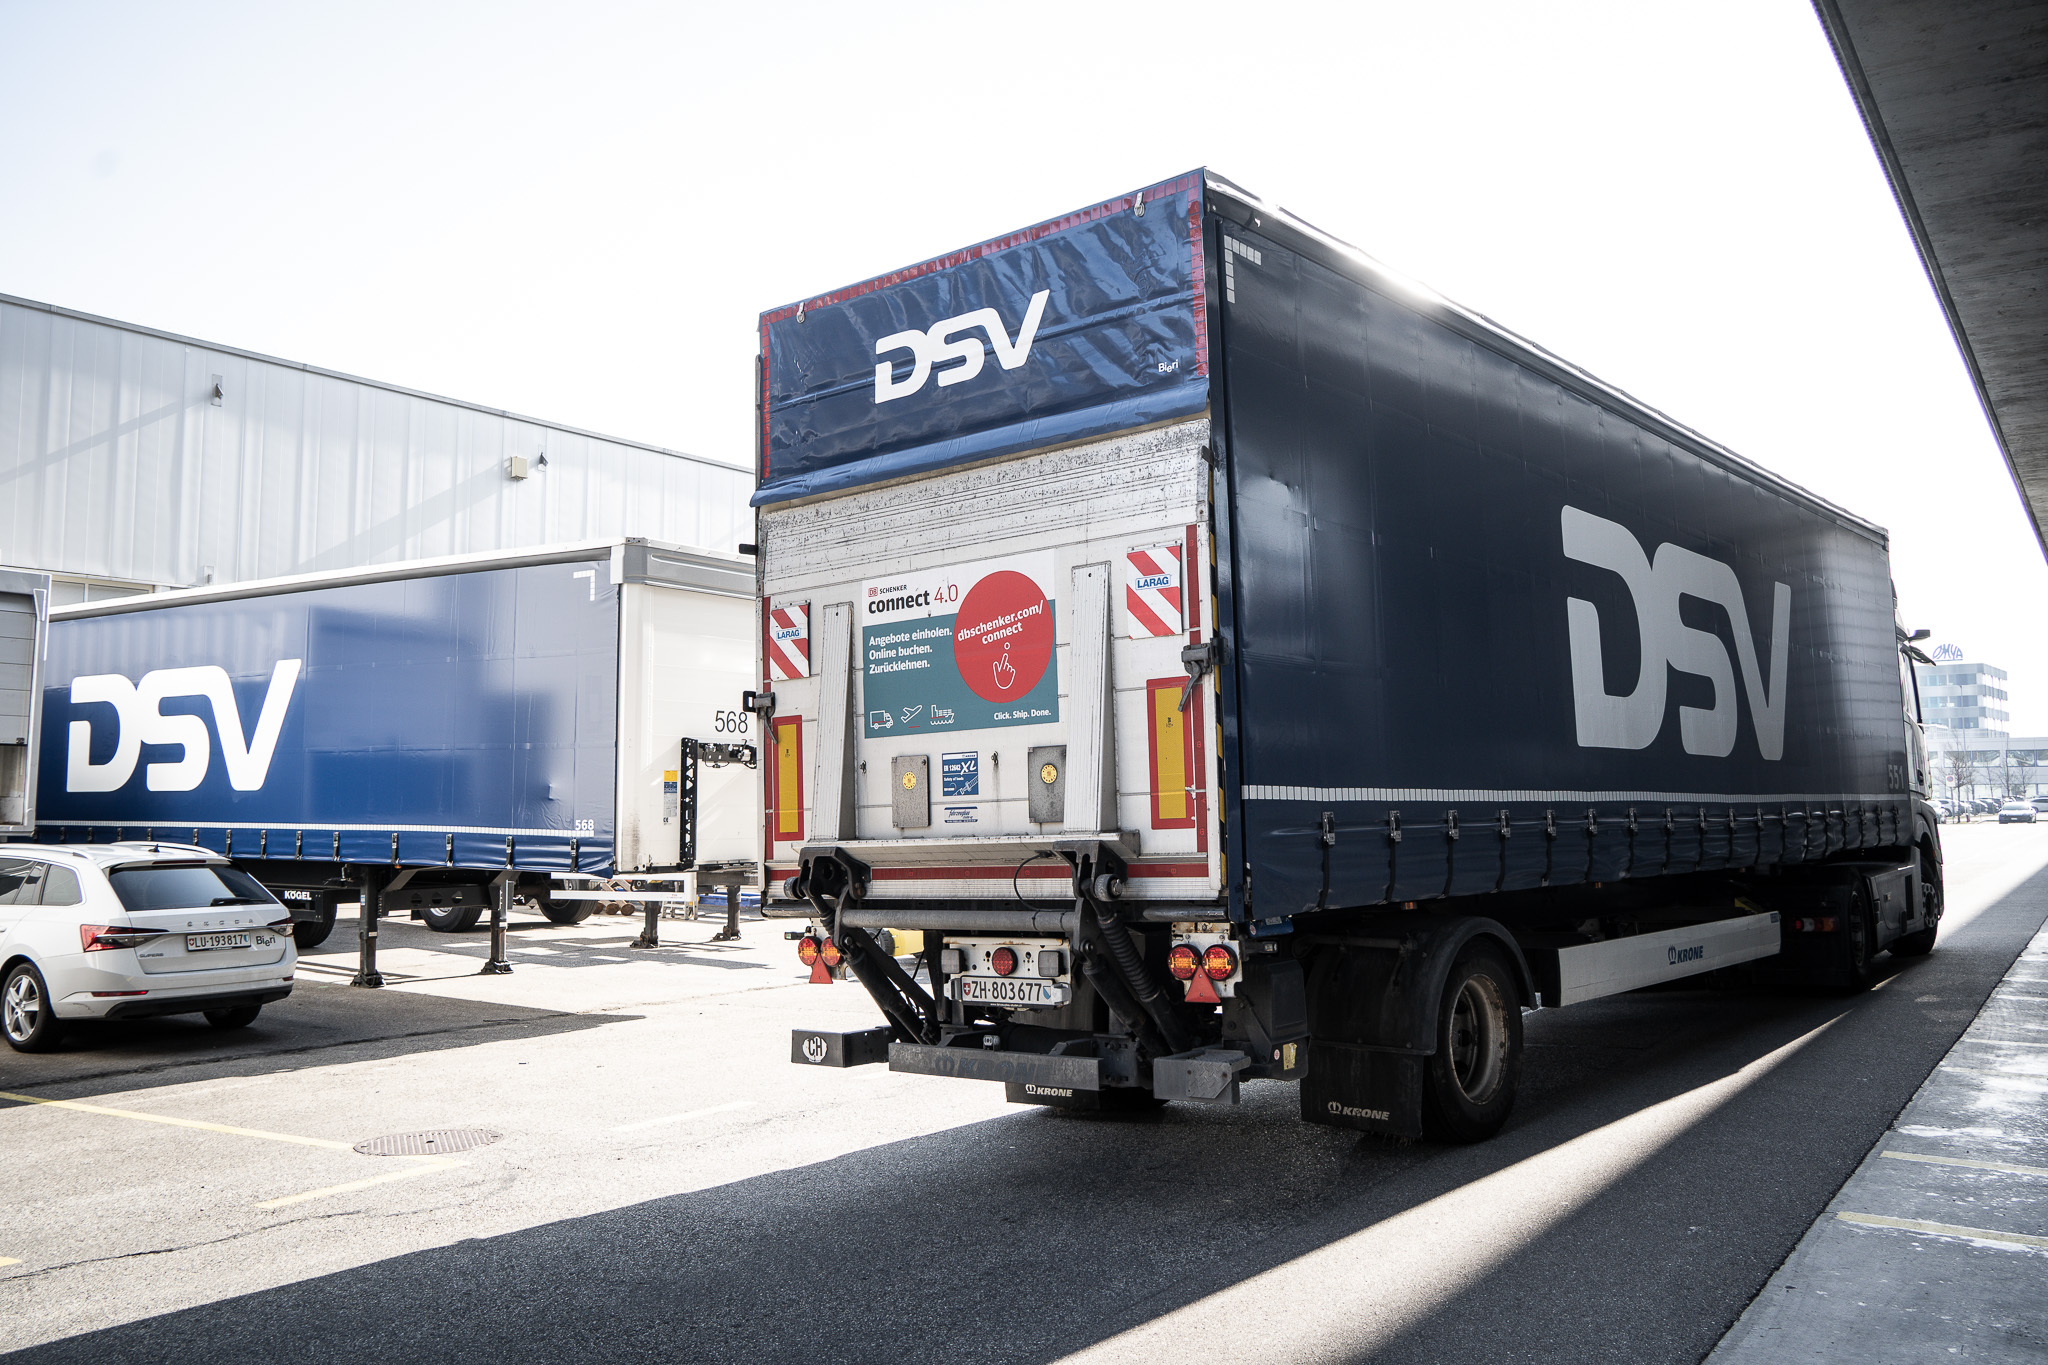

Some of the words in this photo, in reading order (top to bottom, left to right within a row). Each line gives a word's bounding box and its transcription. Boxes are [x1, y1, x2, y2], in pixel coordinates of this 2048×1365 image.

[875, 289, 1050, 404] DSV
[1158, 358, 1178, 372] Bieri
[879, 584, 907, 595] SCHENKER
[1137, 576, 1169, 588] LARAG
[868, 590, 930, 614] connect
[934, 584, 958, 603] 4.0
[957, 600, 1043, 642] dbschenker.com/
[777, 629, 800, 639] LARAG
[869, 631, 910, 647] Angebote
[912, 626, 952, 641] einholen.
[982, 622, 1023, 644] connect
[1561, 504, 1791, 761] DSV
[869, 647, 897, 661] Online
[898, 644, 933, 656] buchen.
[869, 659, 930, 674] Zurücklehnen.
[714, 710, 748, 733] 568
[993, 712, 1012, 721] Click.
[1013, 710, 1030, 720] Ship.
[1031, 709, 1051, 718] Done.
[66, 659, 301, 792] DSV
[961, 760, 977, 776] XL
[1888, 765, 1904, 790] 551
[575, 819, 594, 830] 568
[284, 890, 312, 900] KÖGEL
[256, 935, 276, 946] Bieri
[1677, 945, 1703, 963] KRONE
[808, 1038, 823, 1056] CH
[1036, 1087, 1073, 1097] KRONE
[1342, 1106, 1390, 1120] KRONE
